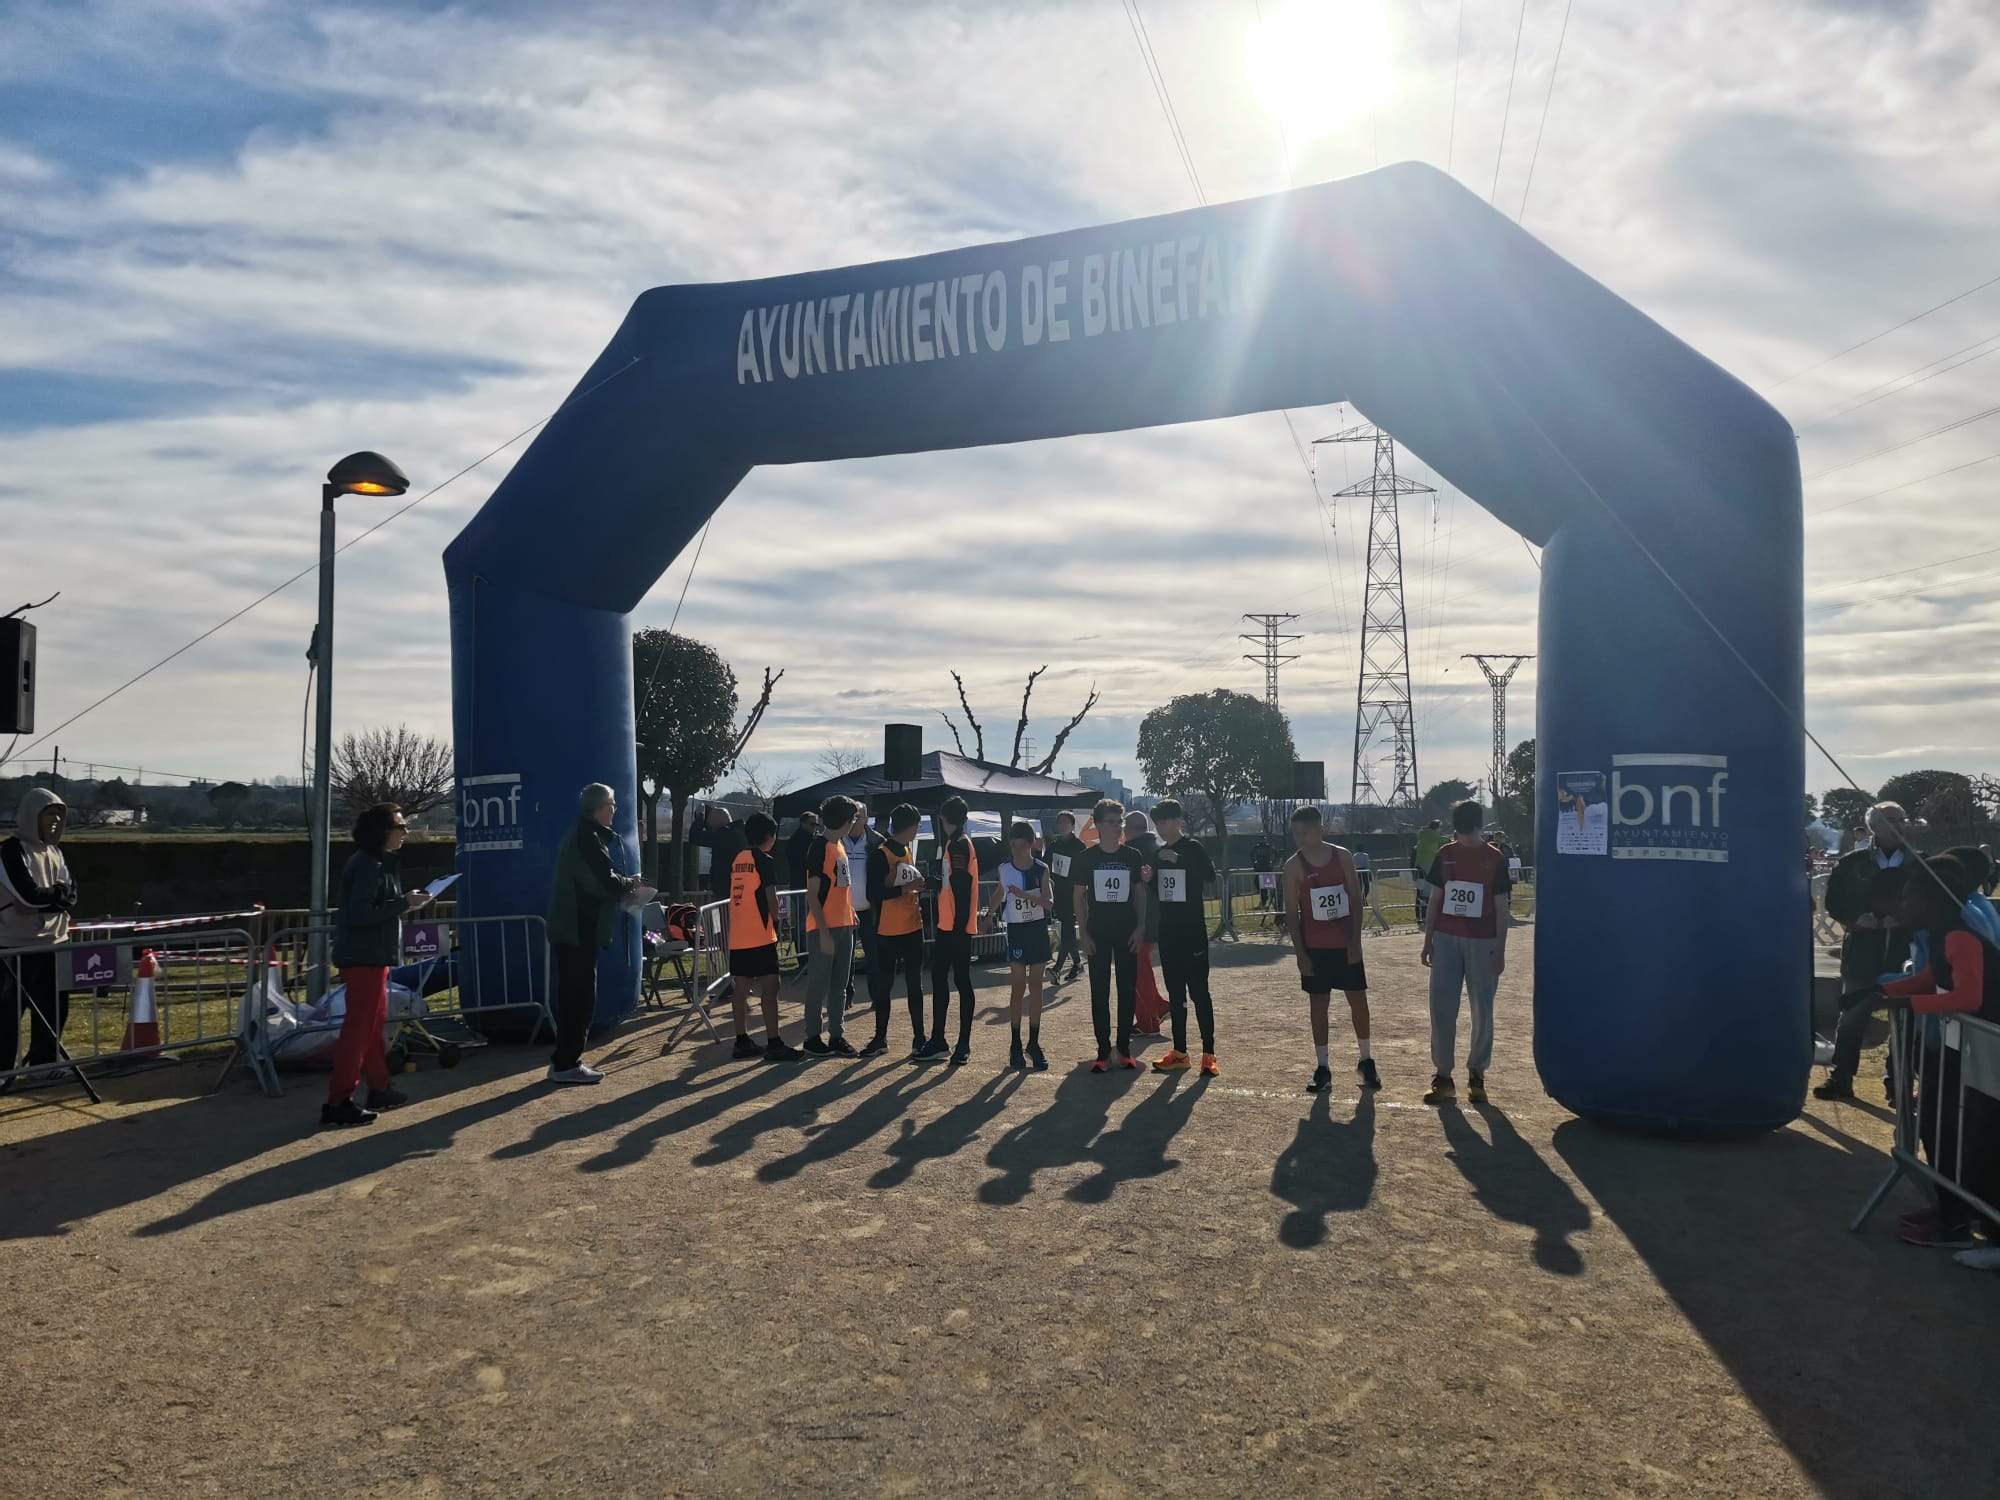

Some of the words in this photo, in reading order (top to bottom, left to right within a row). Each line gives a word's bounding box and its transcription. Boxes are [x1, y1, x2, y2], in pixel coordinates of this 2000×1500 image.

[737, 268, 1008, 385] AYUNTAMIENTO
[1020, 259, 1072, 346] DE
[1081, 232, 1250, 338] BINEFA
[462, 785, 522, 828] bnf
[1612, 770, 1729, 828] bnf
[1613, 829, 1729, 841] AYUNTAMIENTO
[1104, 877, 1120, 890] 40
[1163, 876, 1176, 889] 39
[1318, 892, 1341, 908] 281
[1450, 888, 1475, 904] 280
[75, 970, 114, 982] ALCO
